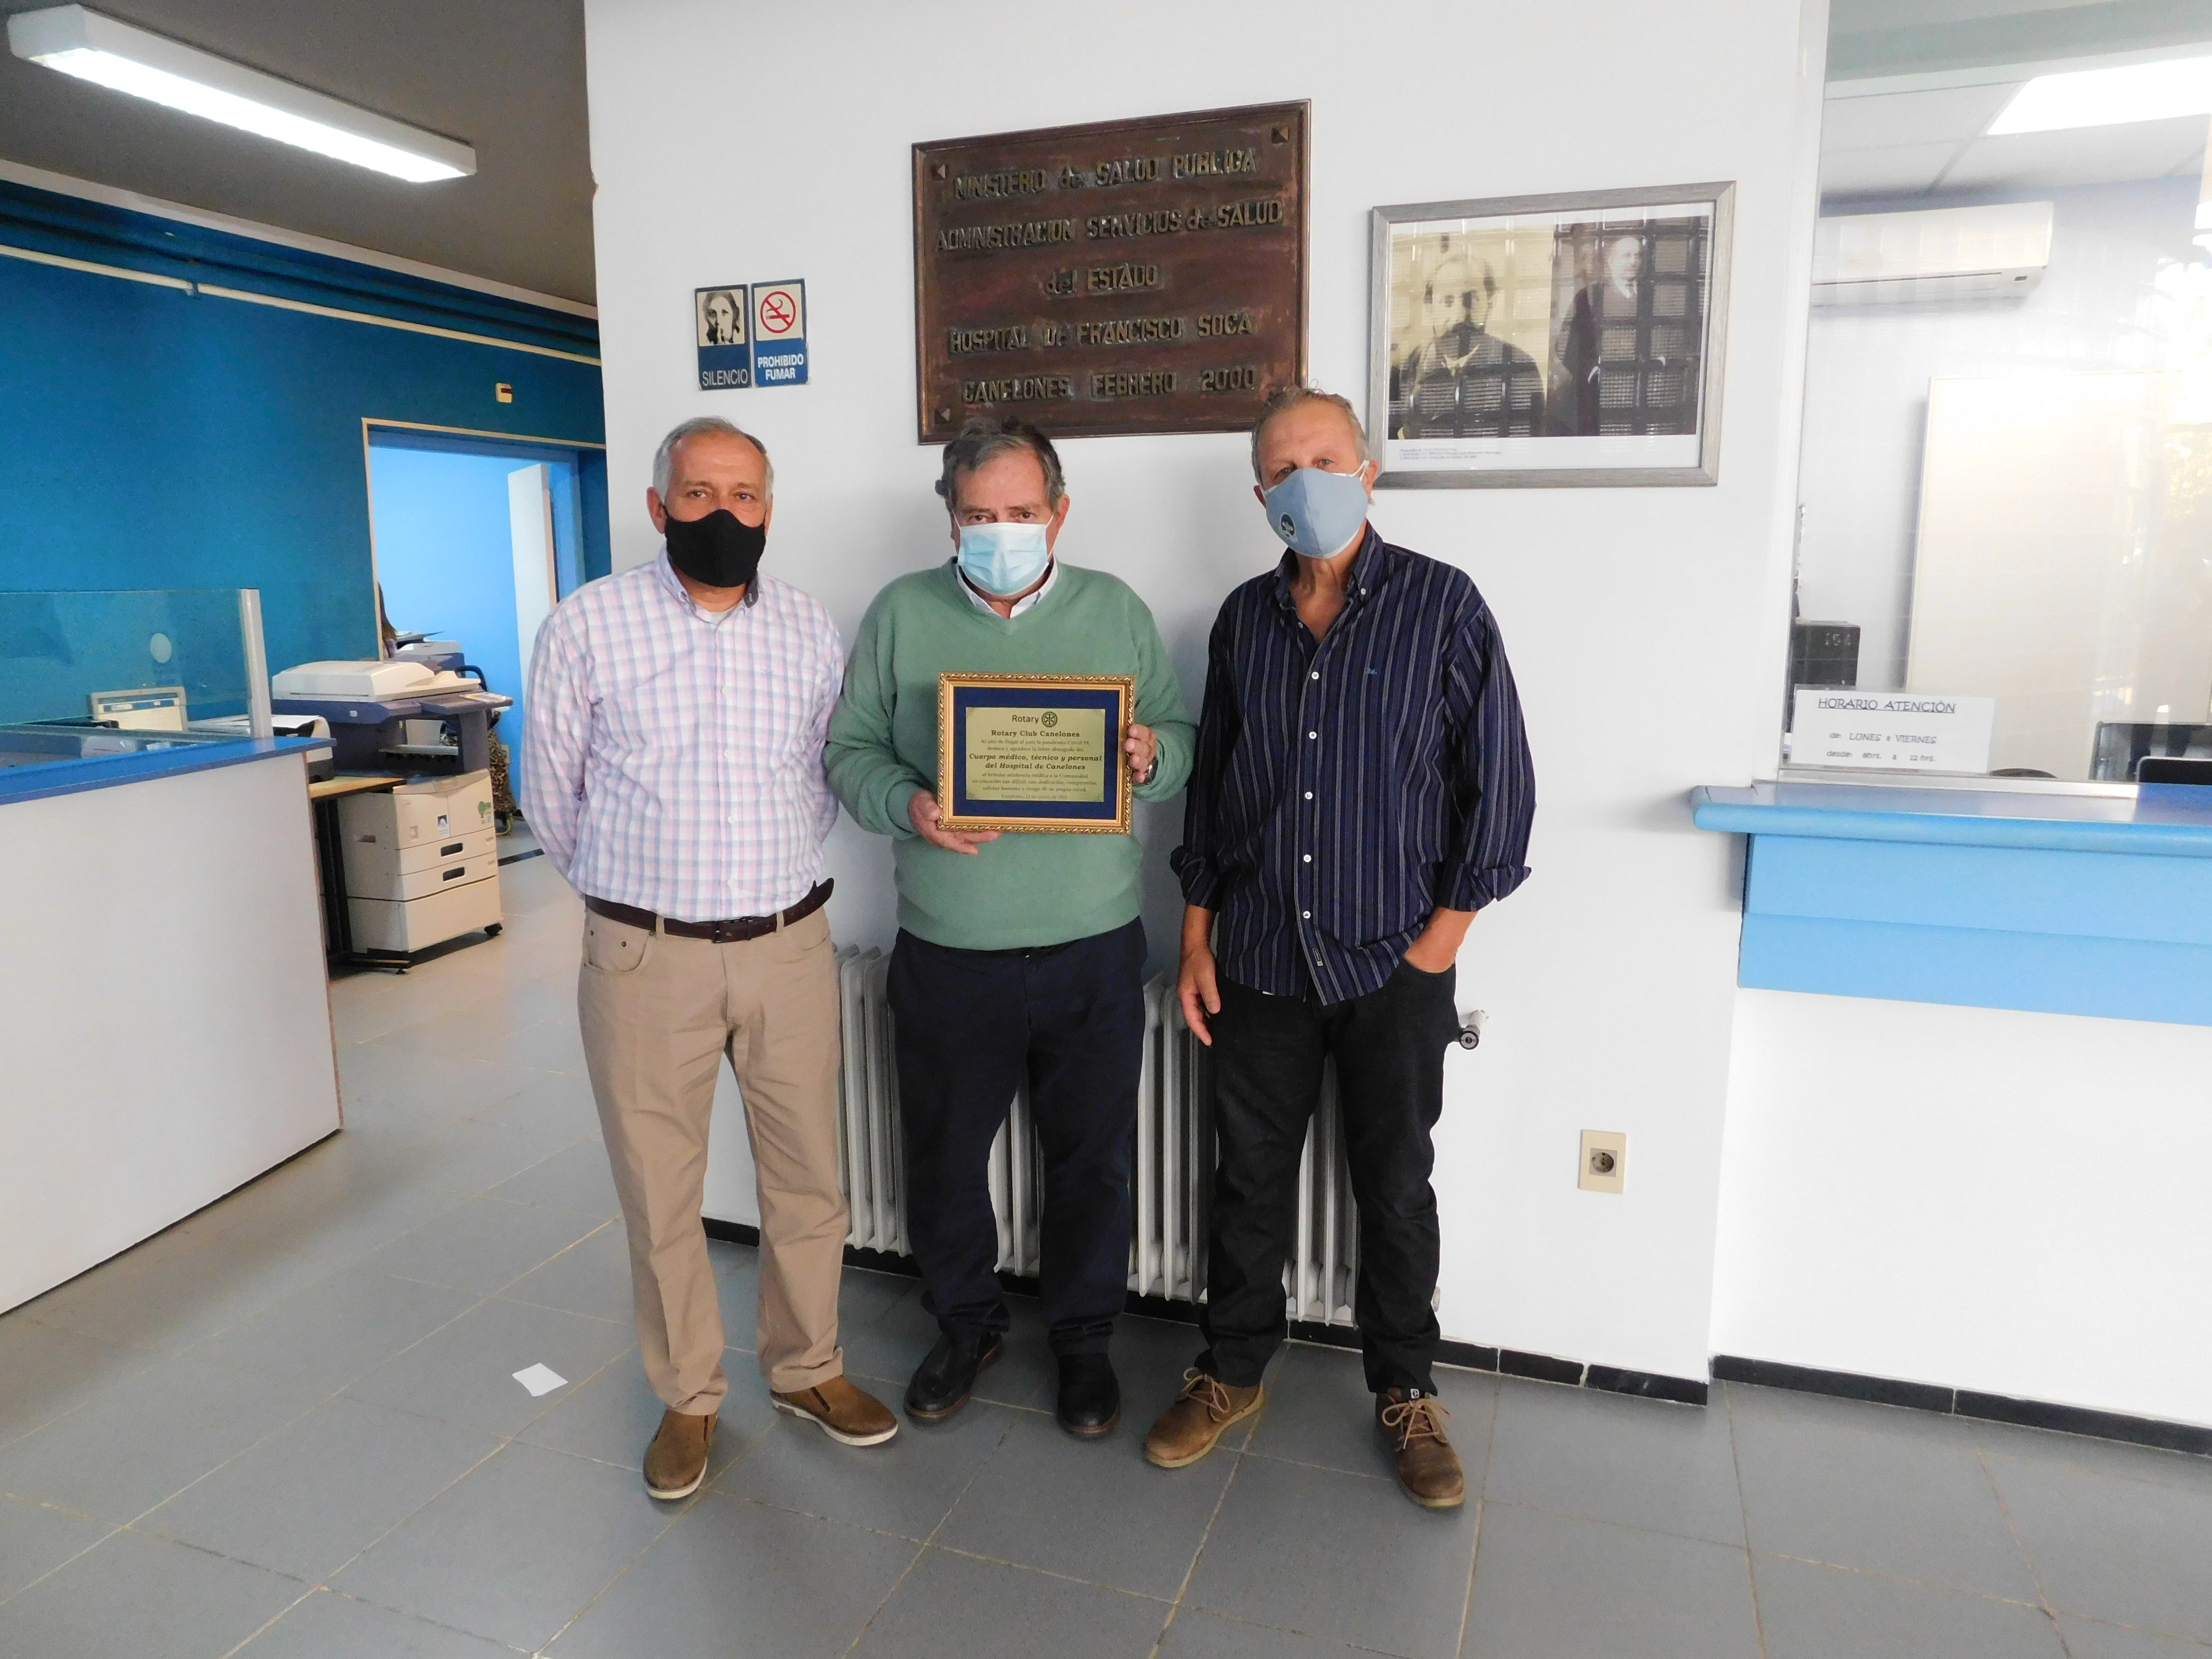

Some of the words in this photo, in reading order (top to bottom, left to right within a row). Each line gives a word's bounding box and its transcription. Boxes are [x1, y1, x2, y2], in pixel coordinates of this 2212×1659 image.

[954, 169, 1046, 199] MINISTERIO
[1096, 158, 1160, 186] SALUD
[1172, 147, 1257, 179] PUBLICA
[935, 218, 1078, 251] ADMINISTRACION
[1087, 209, 1182, 238] SERVICIOS
[1186, 207, 1214, 230] de
[1217, 200, 1283, 227] SALUD
[1045, 269, 1077, 294] del
[1087, 263, 1158, 290] ESTADO
[949, 325, 1030, 353] HOSPITAL
[1076, 316, 1183, 345] FRANCISCO
[1198, 312, 1253, 337] SOCA
[757, 353, 804, 368] PROHIBIDO
[702, 369, 748, 386] SILENCIO
[765, 367, 796, 381] FUMAR
[961, 376, 1071, 403] CANELONES
[1202, 365, 1257, 392] 2000
[1818, 697, 1878, 710] HORARIO
[1012, 714, 1039, 724] Rotary
[1849, 733, 1882, 742] LUNES
[1895, 734, 1937, 744] VIERNES
